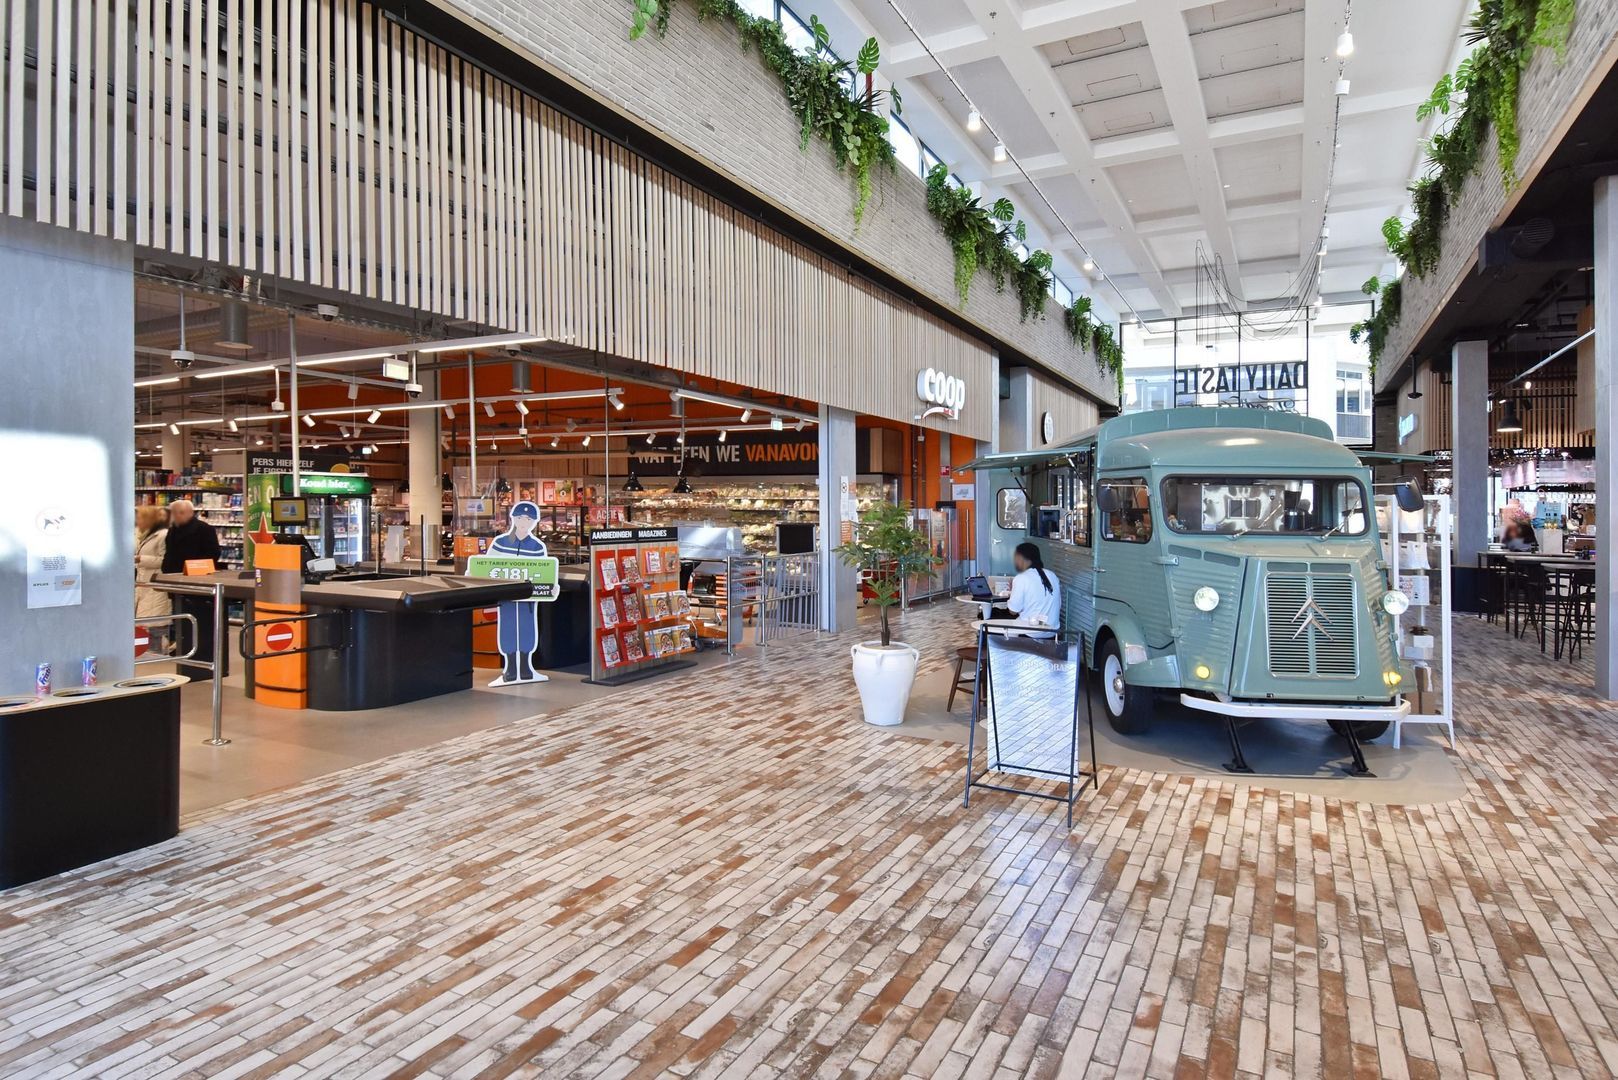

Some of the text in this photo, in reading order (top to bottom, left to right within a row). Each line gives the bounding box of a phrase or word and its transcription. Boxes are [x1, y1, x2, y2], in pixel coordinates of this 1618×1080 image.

[716, 444, 740, 463] WE
[253, 458, 274, 467] PERS
[592, 529, 667, 540] AANBIEDINGEN MAGAZINES
